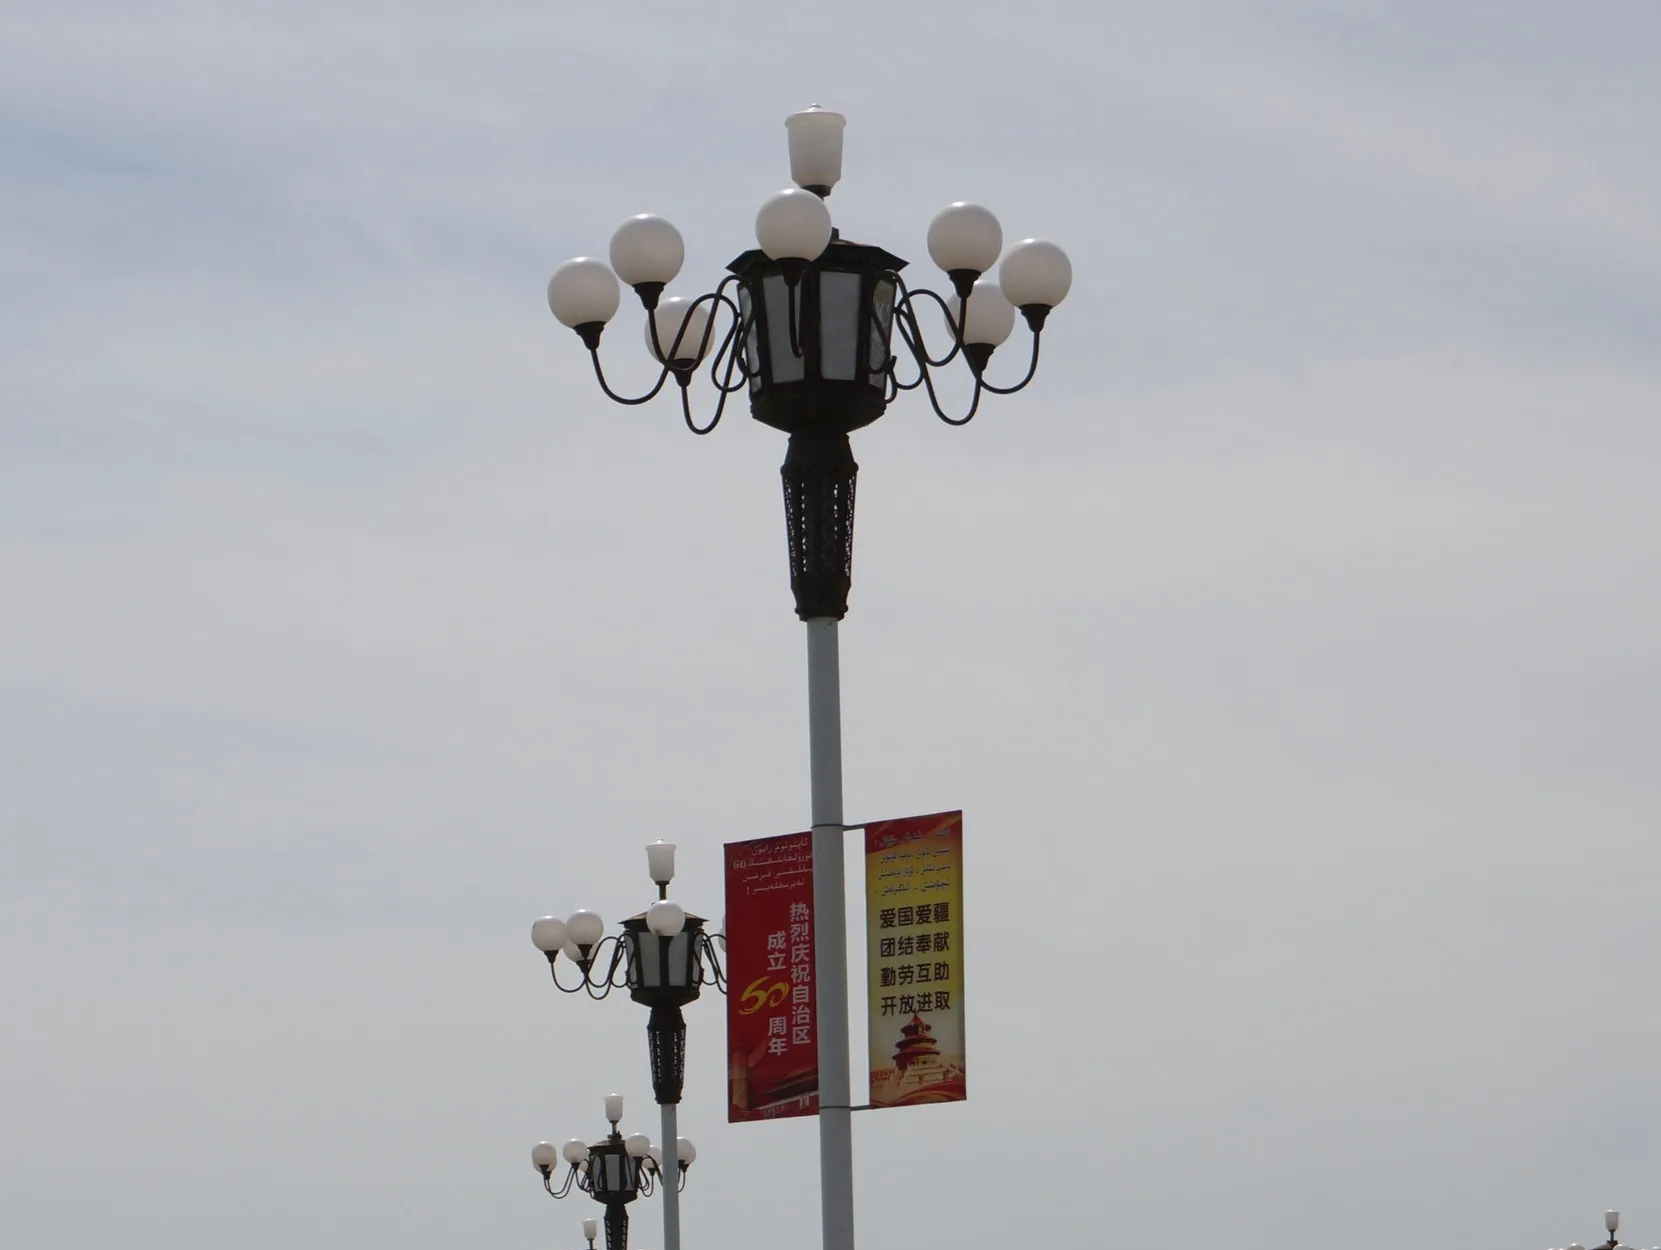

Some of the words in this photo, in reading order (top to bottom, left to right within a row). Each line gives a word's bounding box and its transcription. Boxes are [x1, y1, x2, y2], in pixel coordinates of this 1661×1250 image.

[880, 902, 950, 930] 爱国爱疆
[767, 930, 787, 971] 成立
[880, 931, 950, 958] 团结奉献
[789, 902, 811, 1045] 热烈庆祝自治区
[880, 961, 950, 987] 勤劳互助
[881, 991, 951, 1017] 开放进取
[768, 1016, 788, 1056] 周年
